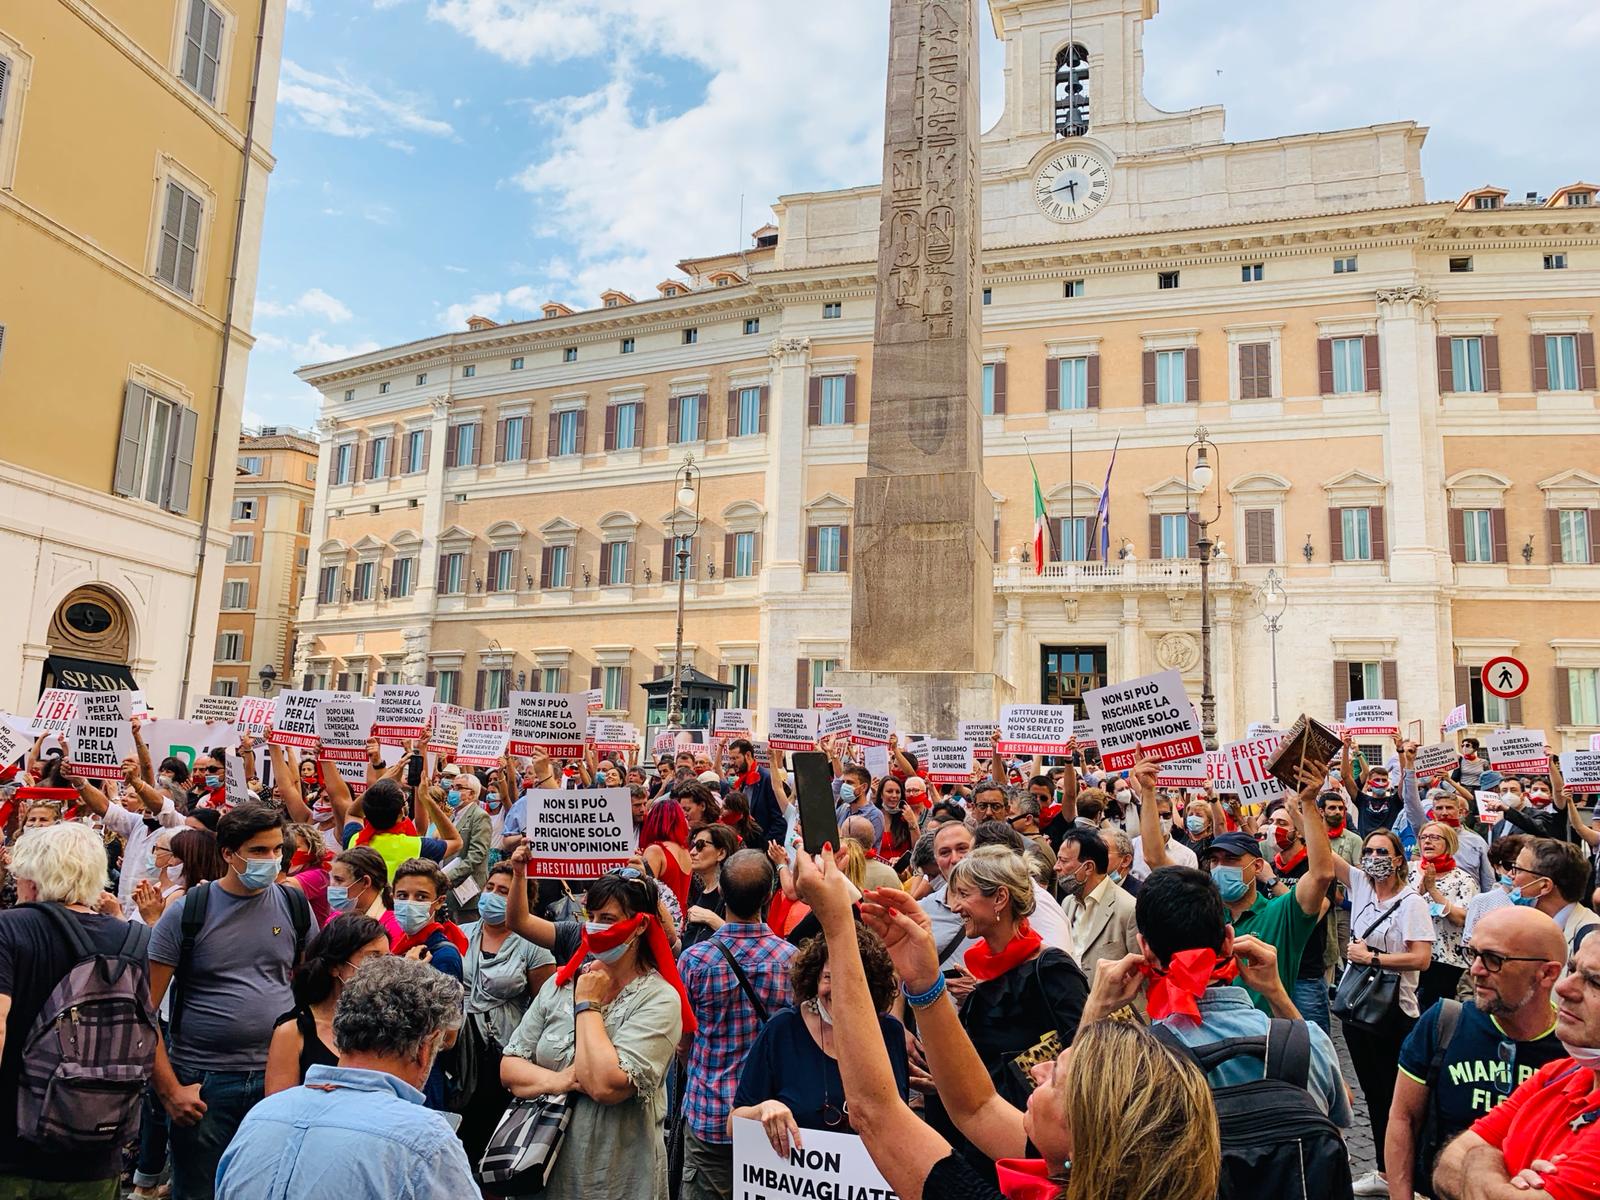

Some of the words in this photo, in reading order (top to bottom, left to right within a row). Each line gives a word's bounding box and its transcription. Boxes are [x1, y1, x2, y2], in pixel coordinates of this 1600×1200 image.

[62, 670, 130, 692] SPADA
[45, 691, 79, 702] #RESTI
[1101, 692, 1123, 706] NON
[1124, 690, 1134, 700] SI
[1134, 681, 1159, 698] PUÒ
[84, 697, 94, 705] IN
[96, 695, 121, 704] PIEDI
[286, 696, 298, 706] IN
[298, 697, 321, 709] PIED
[520, 698, 536, 707] NON
[537, 699, 545, 707] SI
[547, 698, 568, 708] PUÒ
[87, 705, 105, 714] PER
[107, 705, 119, 713] LA
[196, 709, 224, 717] PRIGIONE
[285, 708, 303, 719] PER
[303, 710, 315, 720] LA
[518, 708, 558, 719] RISCHIARE
[560, 711, 573, 719] LA
[1101, 699, 1153, 721] RISCHIARE
[1153, 695, 1171, 708] LA
[238, 708, 275, 726] LIBE
[858, 712, 880, 720] ISTITUIRE
[1101, 716, 1146, 734] PRIGIONE
[1147, 708, 1180, 724] SOLO
[237, 723, 246, 732] DI
[279, 719, 316, 734] LIBERTÀ
[514, 718, 548, 729] PRIGIONE
[549, 721, 577, 730] SOLO
[867, 725, 881, 733] SERVE
[77, 726, 87, 736] IN
[89, 727, 118, 739] PIEDI
[512, 728, 523, 737] PER
[524, 730, 581, 740] UN'OPINIONE
[861, 730, 887, 740] SBAGLIATO
[1016, 733, 1061, 741] SBAGLIATO
[1100, 737, 1119, 749] PER
[1119, 720, 1192, 744] UN'OPINIONE
[78, 739, 98, 751] PER
[101, 741, 114, 751] LA
[272, 734, 318, 748] #RESTIAMOLIBER
[1500, 741, 1544, 751] ESPRESSIONE
[324, 749, 367, 760] #RESTIAMOLIBERI
[1231, 736, 1285, 761] #RESTI
[1516, 748, 1535, 756] TUTTI
[75, 750, 118, 765] LIBERTÀ
[941, 753, 965, 761] LIBERTÀ
[938, 762, 967, 770] OPINIONE
[1234, 755, 1275, 785] LIB
[72, 766, 124, 779] #RESTIAMOLIBER
[1243, 785, 1258, 799] DI
[1260, 780, 1287, 795] PEN
[543, 798, 566, 809] NON
[568, 799, 578, 809] SI
[581, 794, 608, 809] PUÒ
[539, 812, 597, 824] RISCHIARE
[599, 812, 615, 823] LA
[534, 827, 586, 838] PRIGIONE
[587, 826, 622, 838] SOLO
[530, 841, 549, 852] PER
[551, 841, 629, 852] UN'OPINIONE
[1447, 1060, 1511, 1086] MIAMI
[790, 1147, 841, 1174] NON
